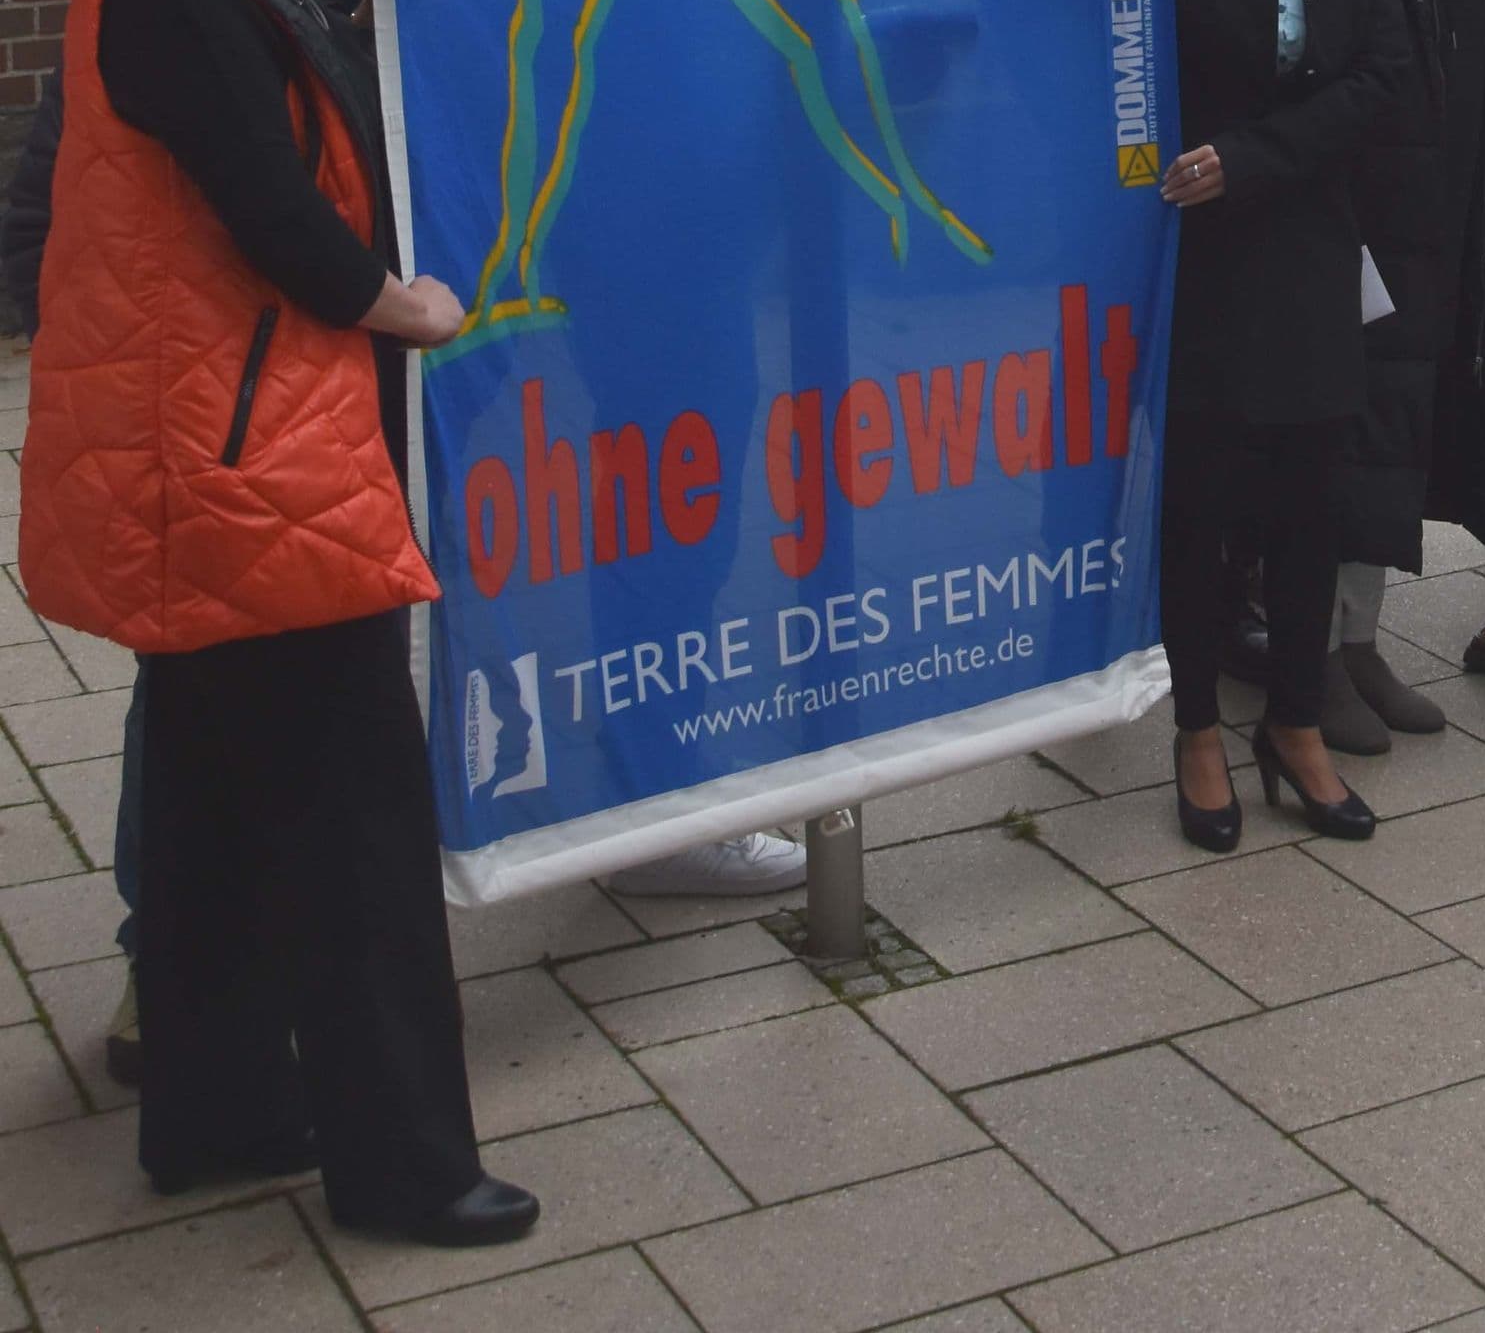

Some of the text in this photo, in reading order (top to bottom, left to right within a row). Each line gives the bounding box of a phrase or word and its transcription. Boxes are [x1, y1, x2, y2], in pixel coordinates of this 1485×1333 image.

[1146, 61, 1158, 142] STUTTGARTER
[464, 283, 1139, 600] ohne gewalt
[554, 535, 1127, 723] TERRE DES FEMMES
[672, 627, 1035, 746] www.frauenrechte.de
